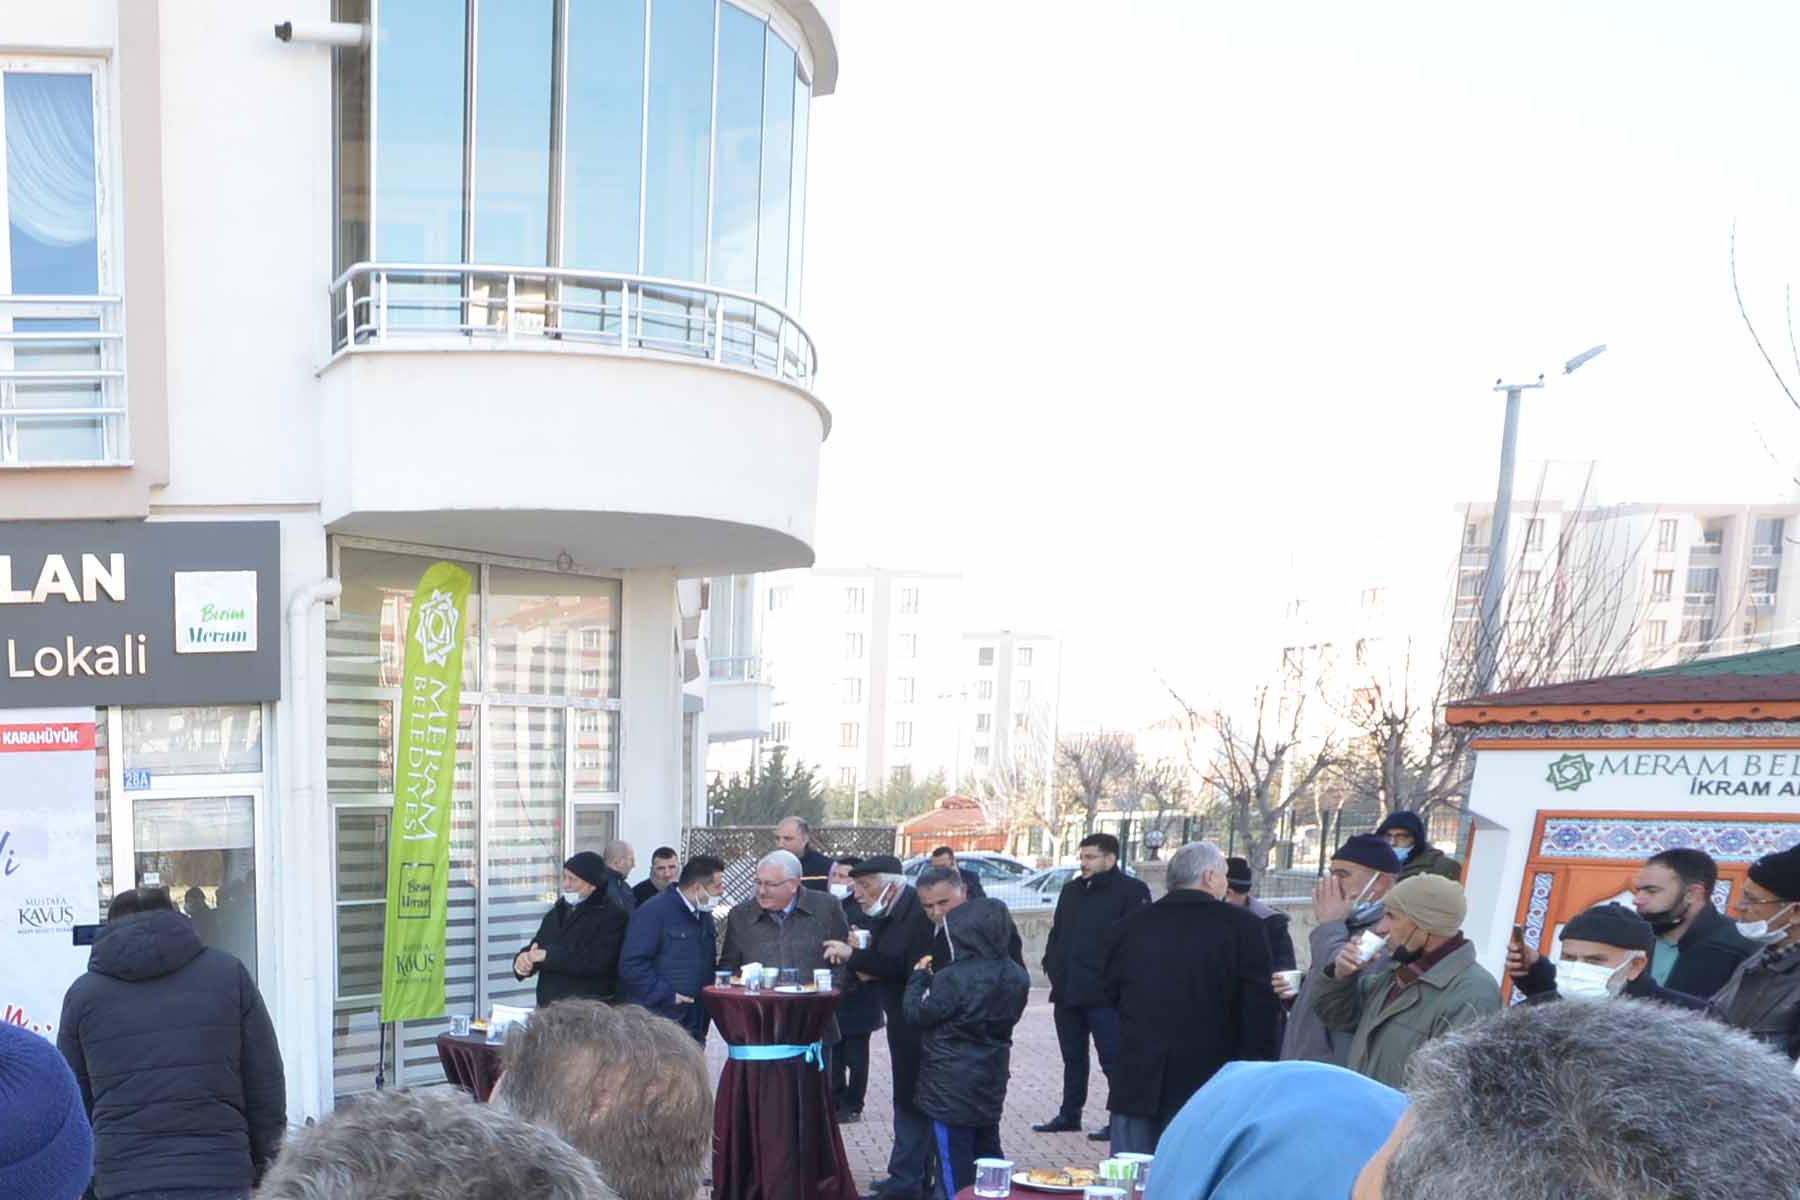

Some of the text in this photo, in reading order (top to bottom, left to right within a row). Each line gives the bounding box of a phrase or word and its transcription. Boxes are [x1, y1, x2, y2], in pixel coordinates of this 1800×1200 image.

[186, 626, 248, 644] Meram
[7, 633, 148, 679] Lokali
[2, 727, 79, 745] KARAHÜYÜK
[1598, 753, 1730, 777] MERAM
[1690, 775, 1800, 796] İKRAM A
[18, 906, 74, 928] KAVUŞ
